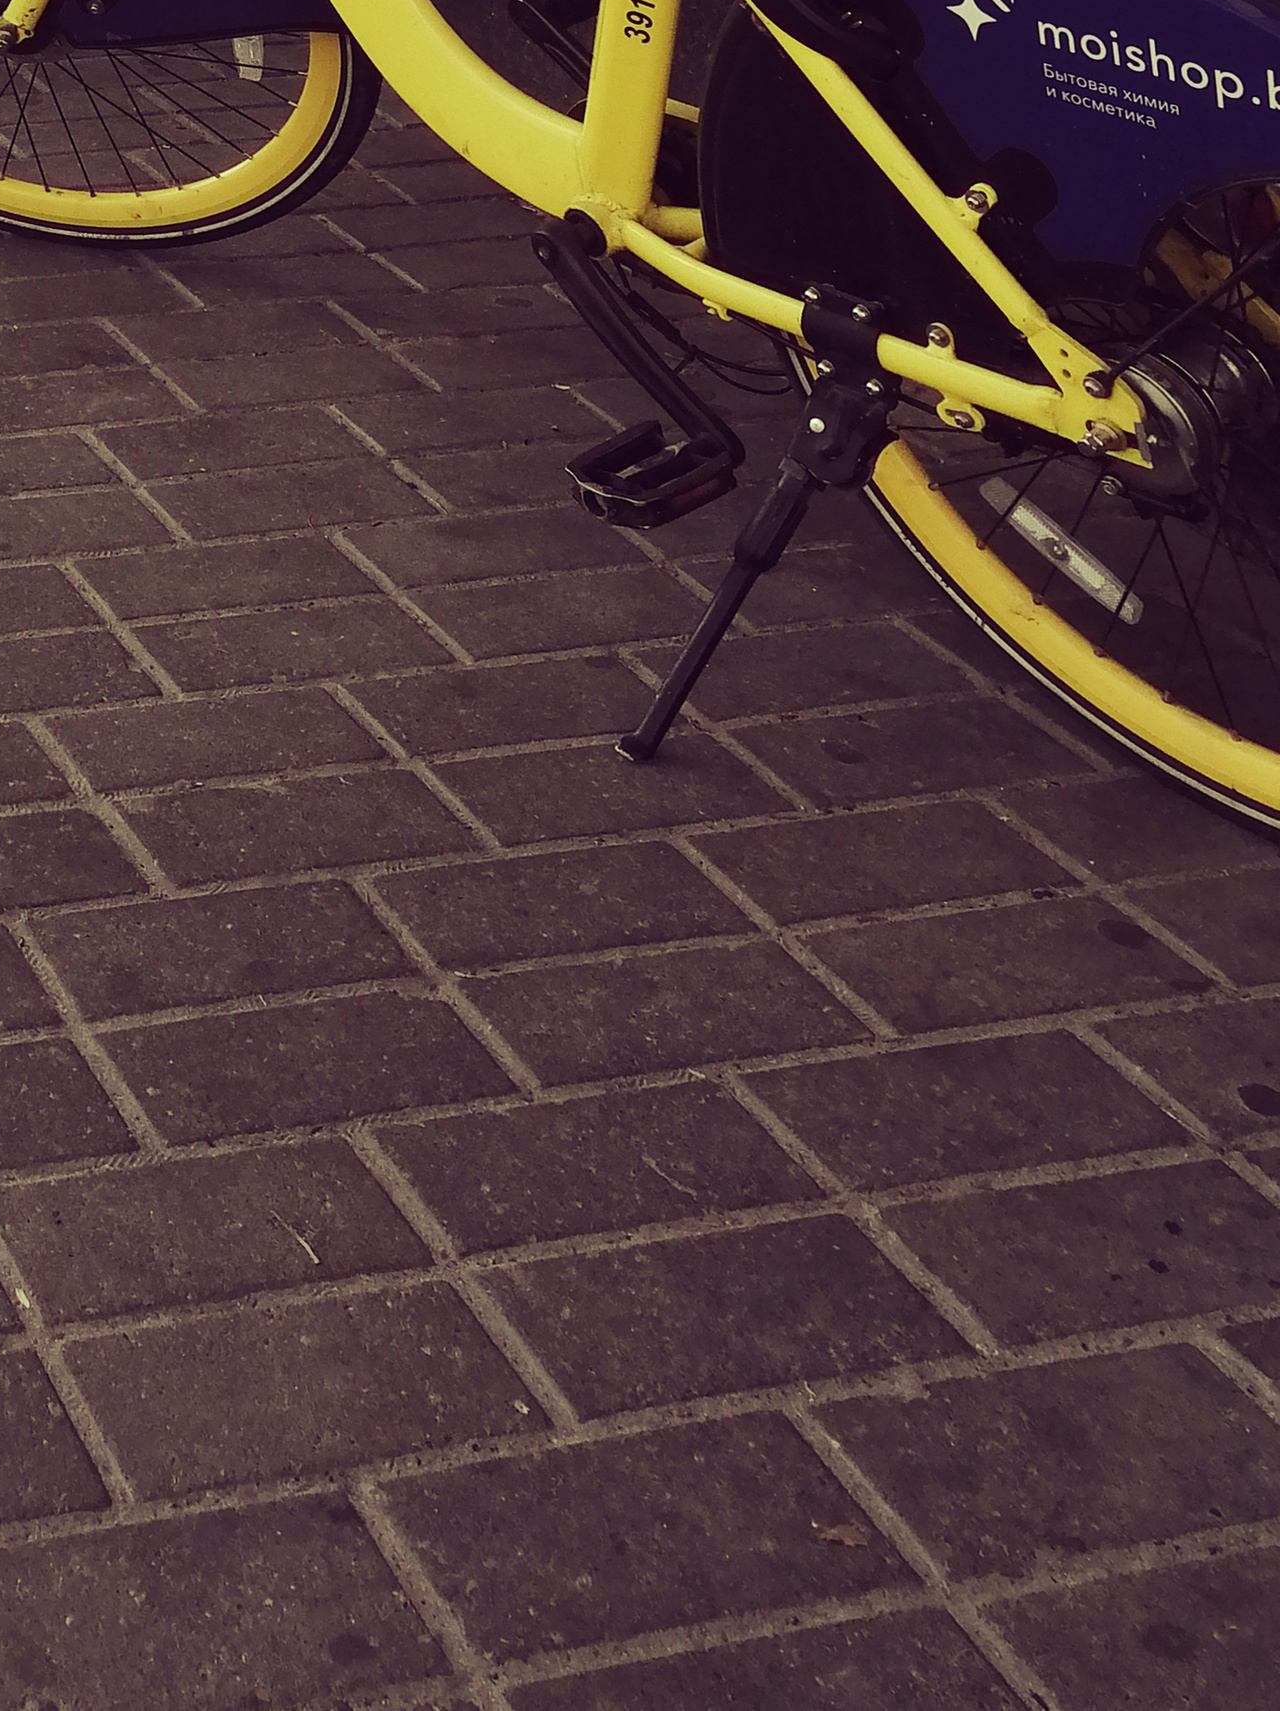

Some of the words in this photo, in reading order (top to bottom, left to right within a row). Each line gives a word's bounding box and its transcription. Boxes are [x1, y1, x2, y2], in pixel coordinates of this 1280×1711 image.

[1042, 63, 1119, 98] Бытовая
[1122, 89, 1181, 116] химия
[1046, 86, 1057, 99] и
[1061, 90, 1158, 129] косметика
